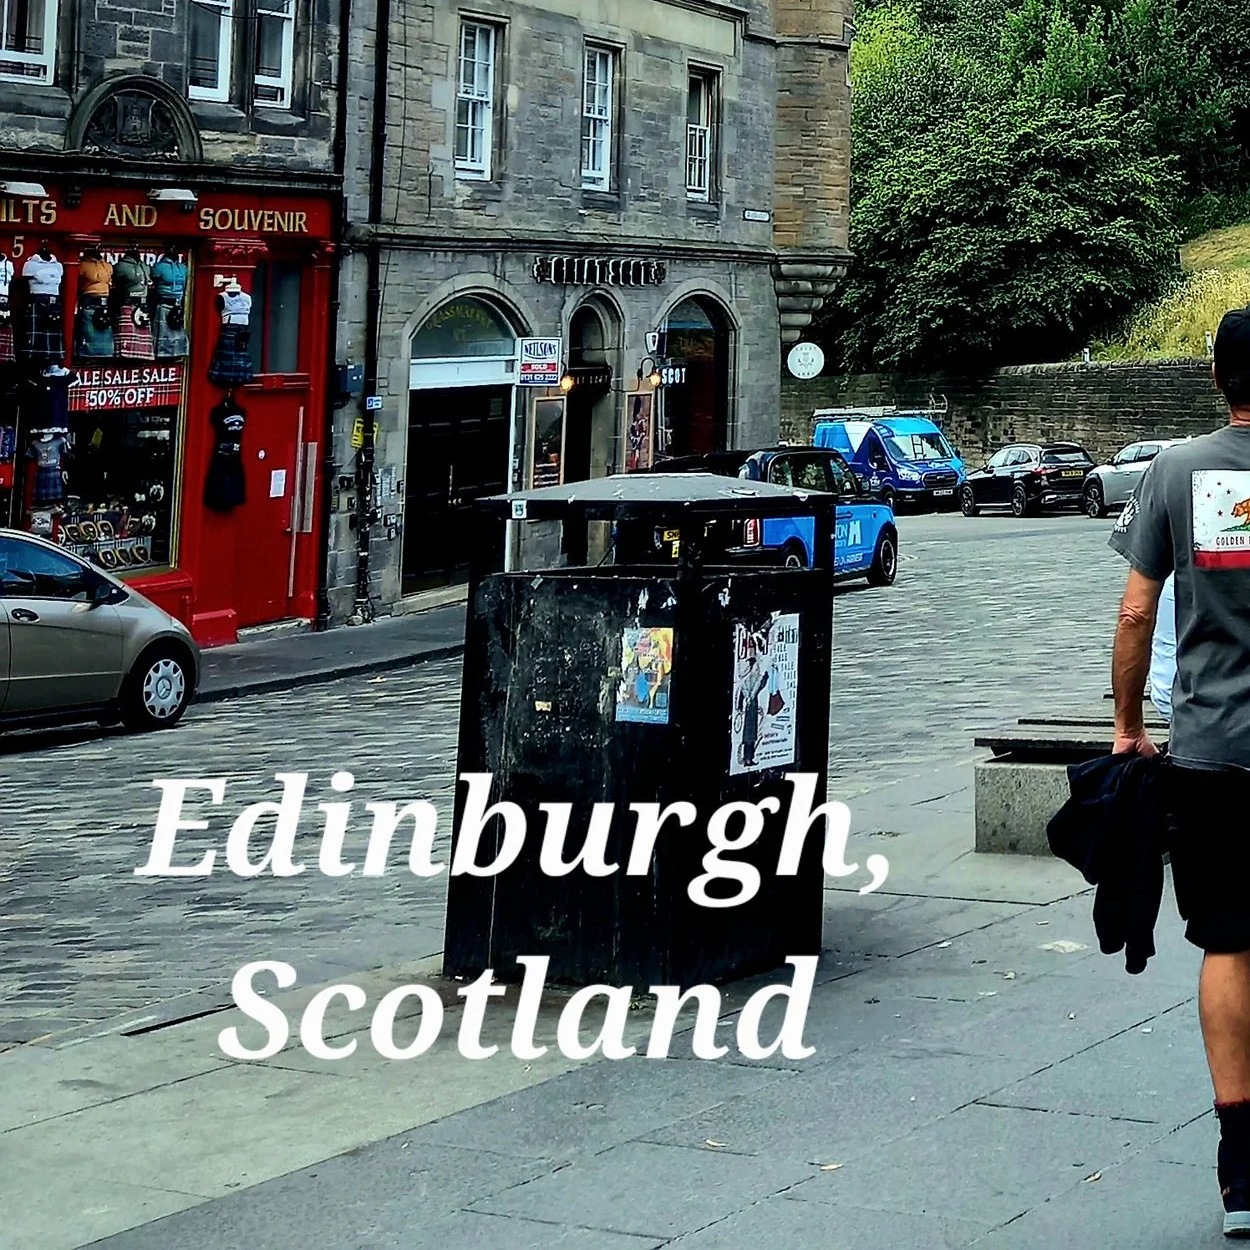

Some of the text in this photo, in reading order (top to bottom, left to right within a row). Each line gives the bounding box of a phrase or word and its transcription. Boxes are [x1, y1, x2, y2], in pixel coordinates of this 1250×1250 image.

[104, 204, 157, 227] AND
[199, 208, 308, 233] SOUVENIR
[11, 235, 24, 258] 5
[74, 367, 176, 386] ALE SALE SALE
[531, 363, 548, 371] SOLD
[661, 367, 687, 384] SCOT
[88, 387, 155, 407] 50% OFF
[1216, 535, 1245, 546] GOLDEN
